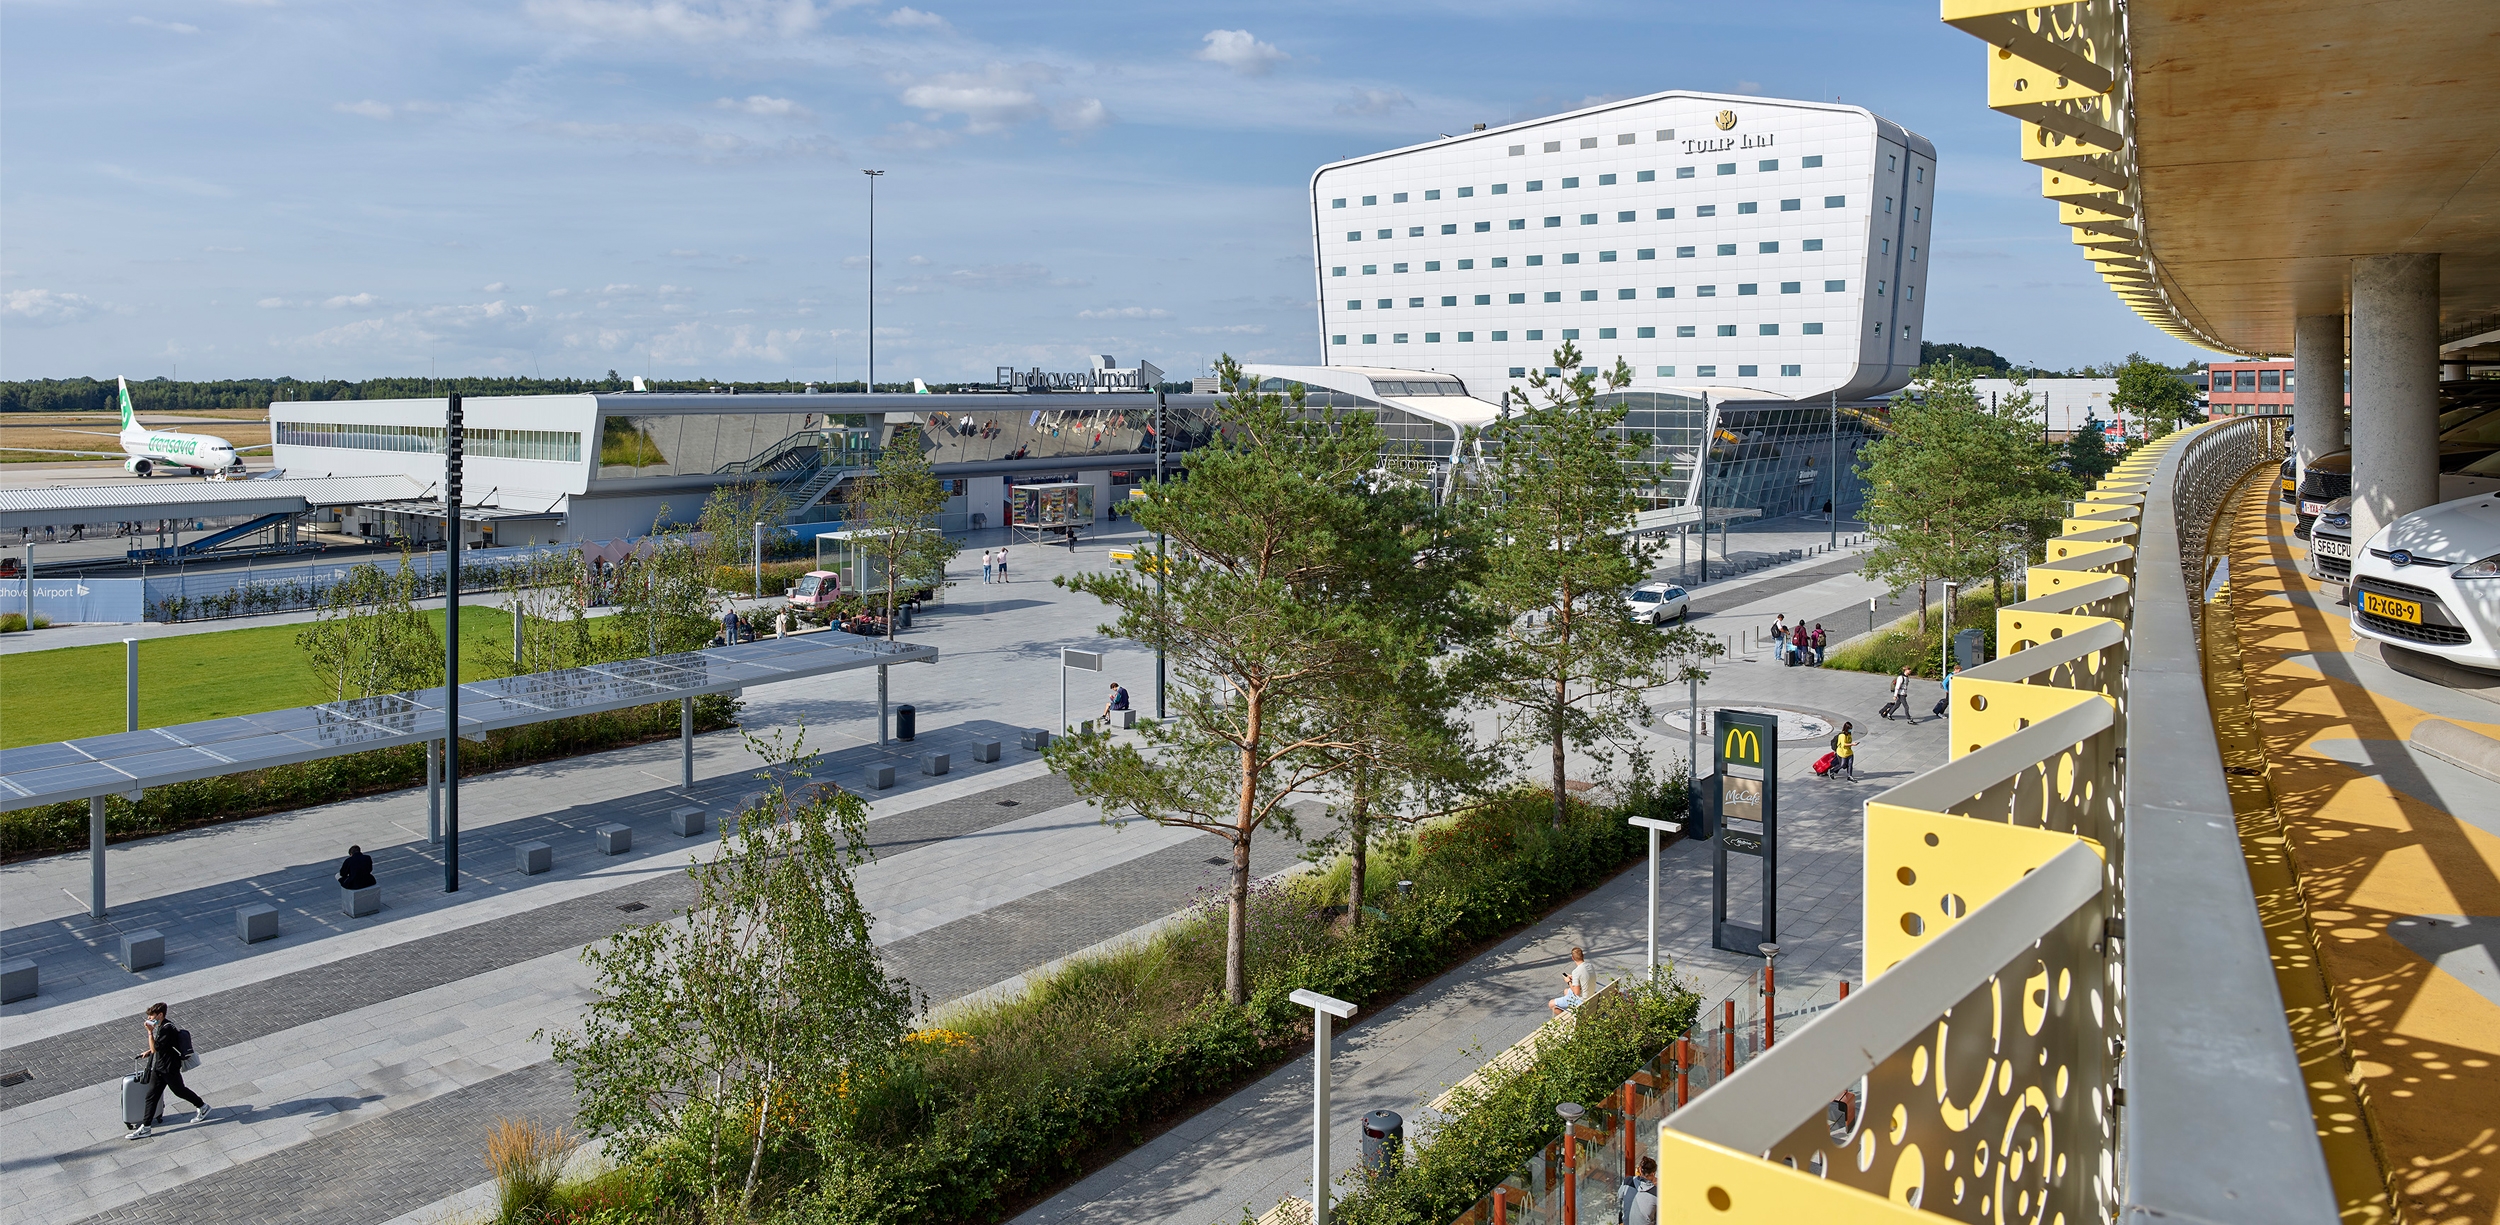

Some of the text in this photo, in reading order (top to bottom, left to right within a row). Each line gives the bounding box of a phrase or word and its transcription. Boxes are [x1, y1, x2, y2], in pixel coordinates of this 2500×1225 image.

[996, 366, 1142, 389] EindhovenAirport
[148, 435, 198, 456] transavia
[1375, 456, 1437, 470] Welcome
[2317, 540, 2351, 557] SF63 CPU
[238, 572, 332, 589] EindhovenAirport
[2368, 596, 2415, 620] 12-XGB-9
